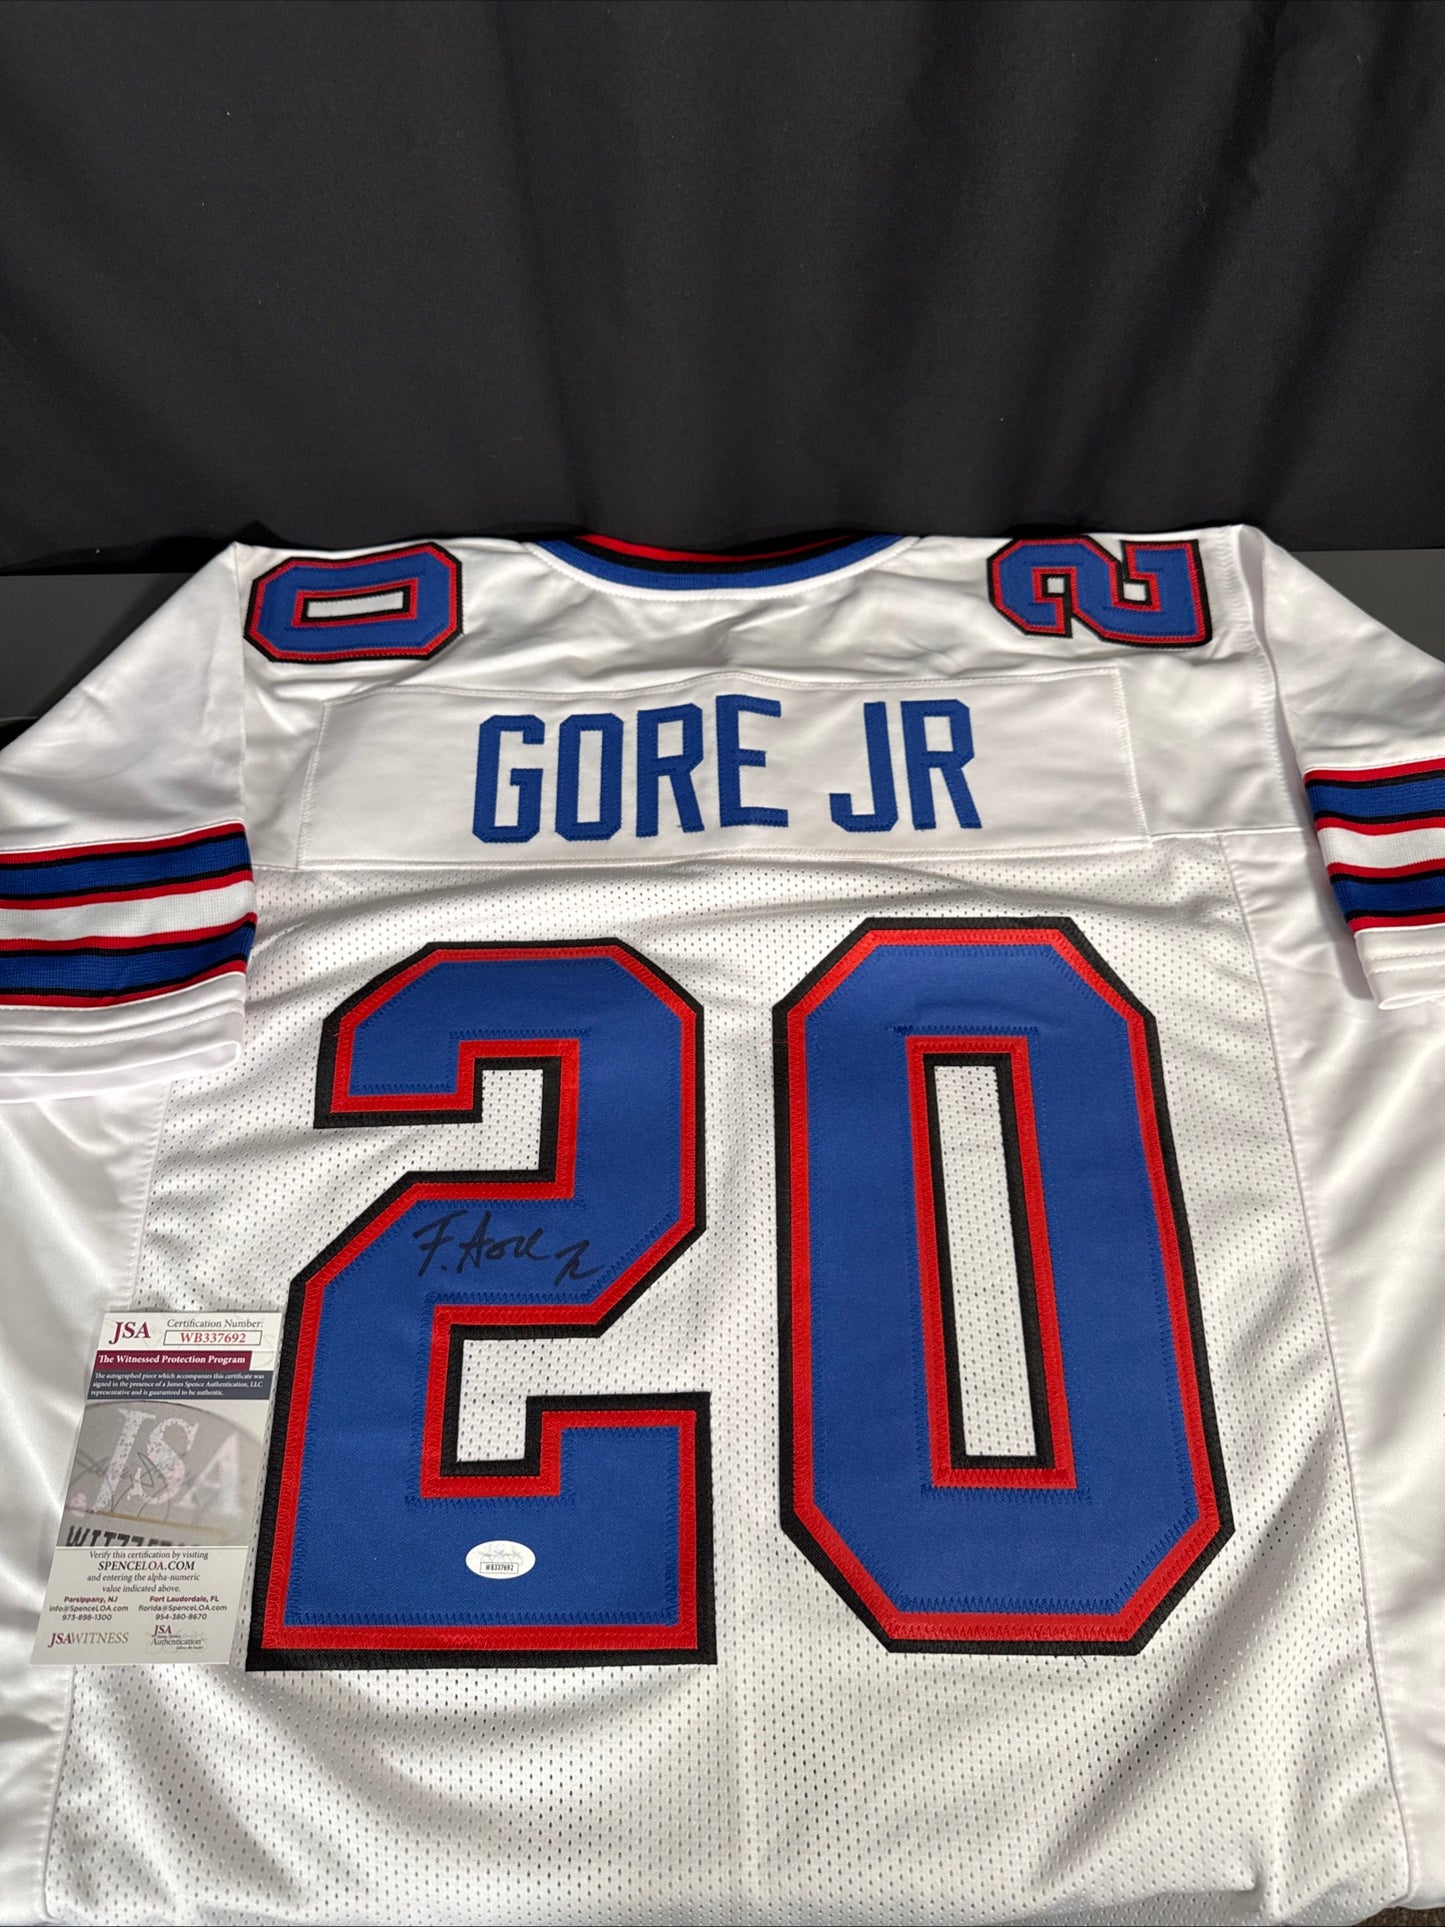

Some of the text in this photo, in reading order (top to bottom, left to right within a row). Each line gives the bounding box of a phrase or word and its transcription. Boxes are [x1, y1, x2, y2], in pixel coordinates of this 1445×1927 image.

[471, 694, 983, 846] GORE JR
[246, 916, 1235, 1671] 20
[167, 1319, 264, 1328] Certification Number:
[109, 1321, 151, 1344] JSA
[180, 1332, 246, 1343] WB337692
[98, 1355, 246, 1365] The Witnessed Protection Program
[106, 1372, 141, 1380] autographed
[90, 1551, 111, 1560] Verify
[172, 1551, 181, 1560] by
[182, 1551, 209, 1560] visiting
[97, 1561, 195, 1571] SPENCELOA.COM
[87, 1573, 200, 1583] and entering the alpha-numeric
[102, 1584, 181, 1592] value indicated above.
[64, 1596, 106, 1604] Parsippany,
[151, 1624, 172, 1637] JSA
